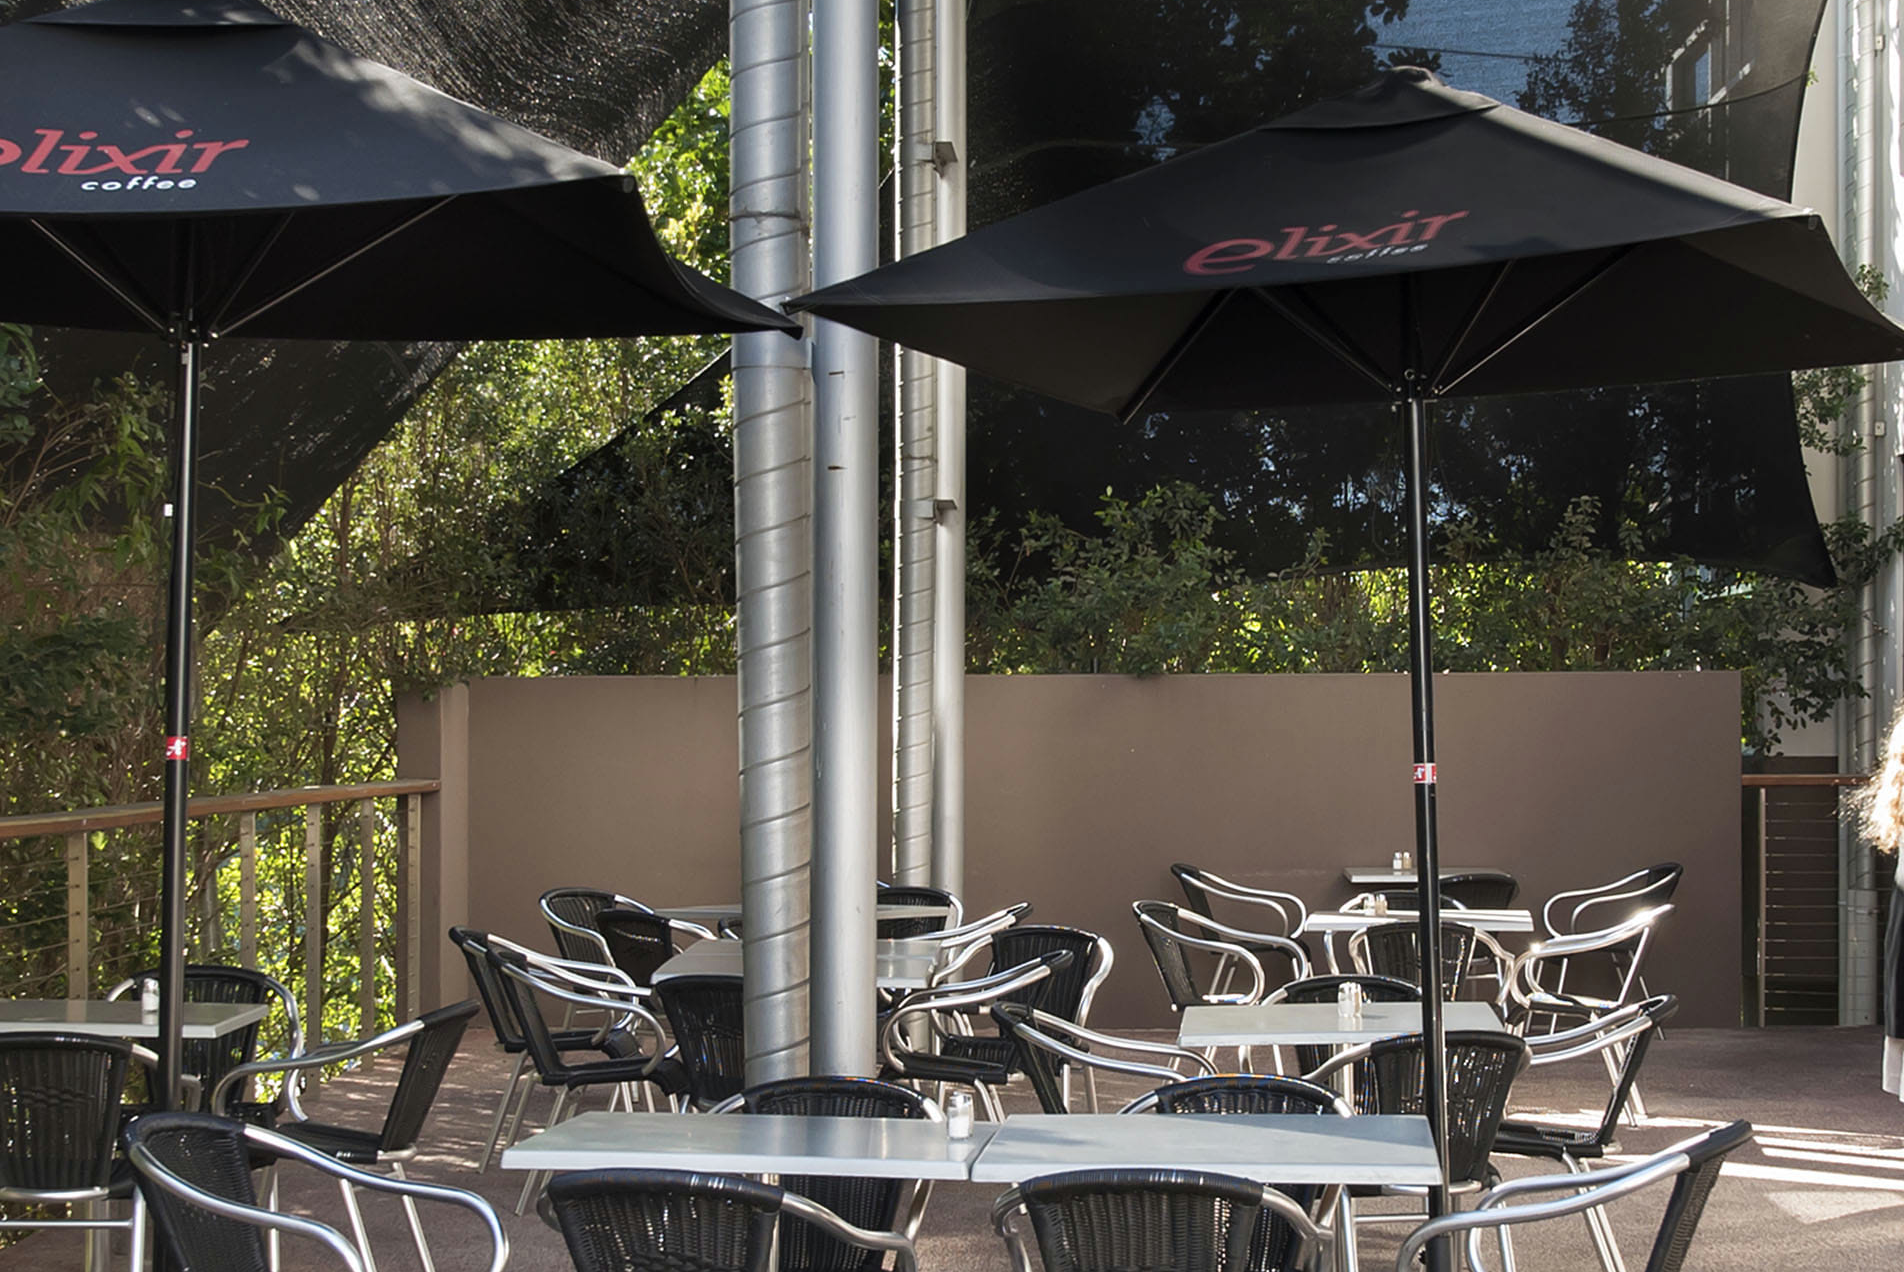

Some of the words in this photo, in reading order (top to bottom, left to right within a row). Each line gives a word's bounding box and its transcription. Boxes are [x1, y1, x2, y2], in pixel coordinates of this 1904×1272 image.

[81, 175, 196, 191] coffee
[1183, 210, 1469, 275] elixir
[1326, 243, 1428, 265] coffee
